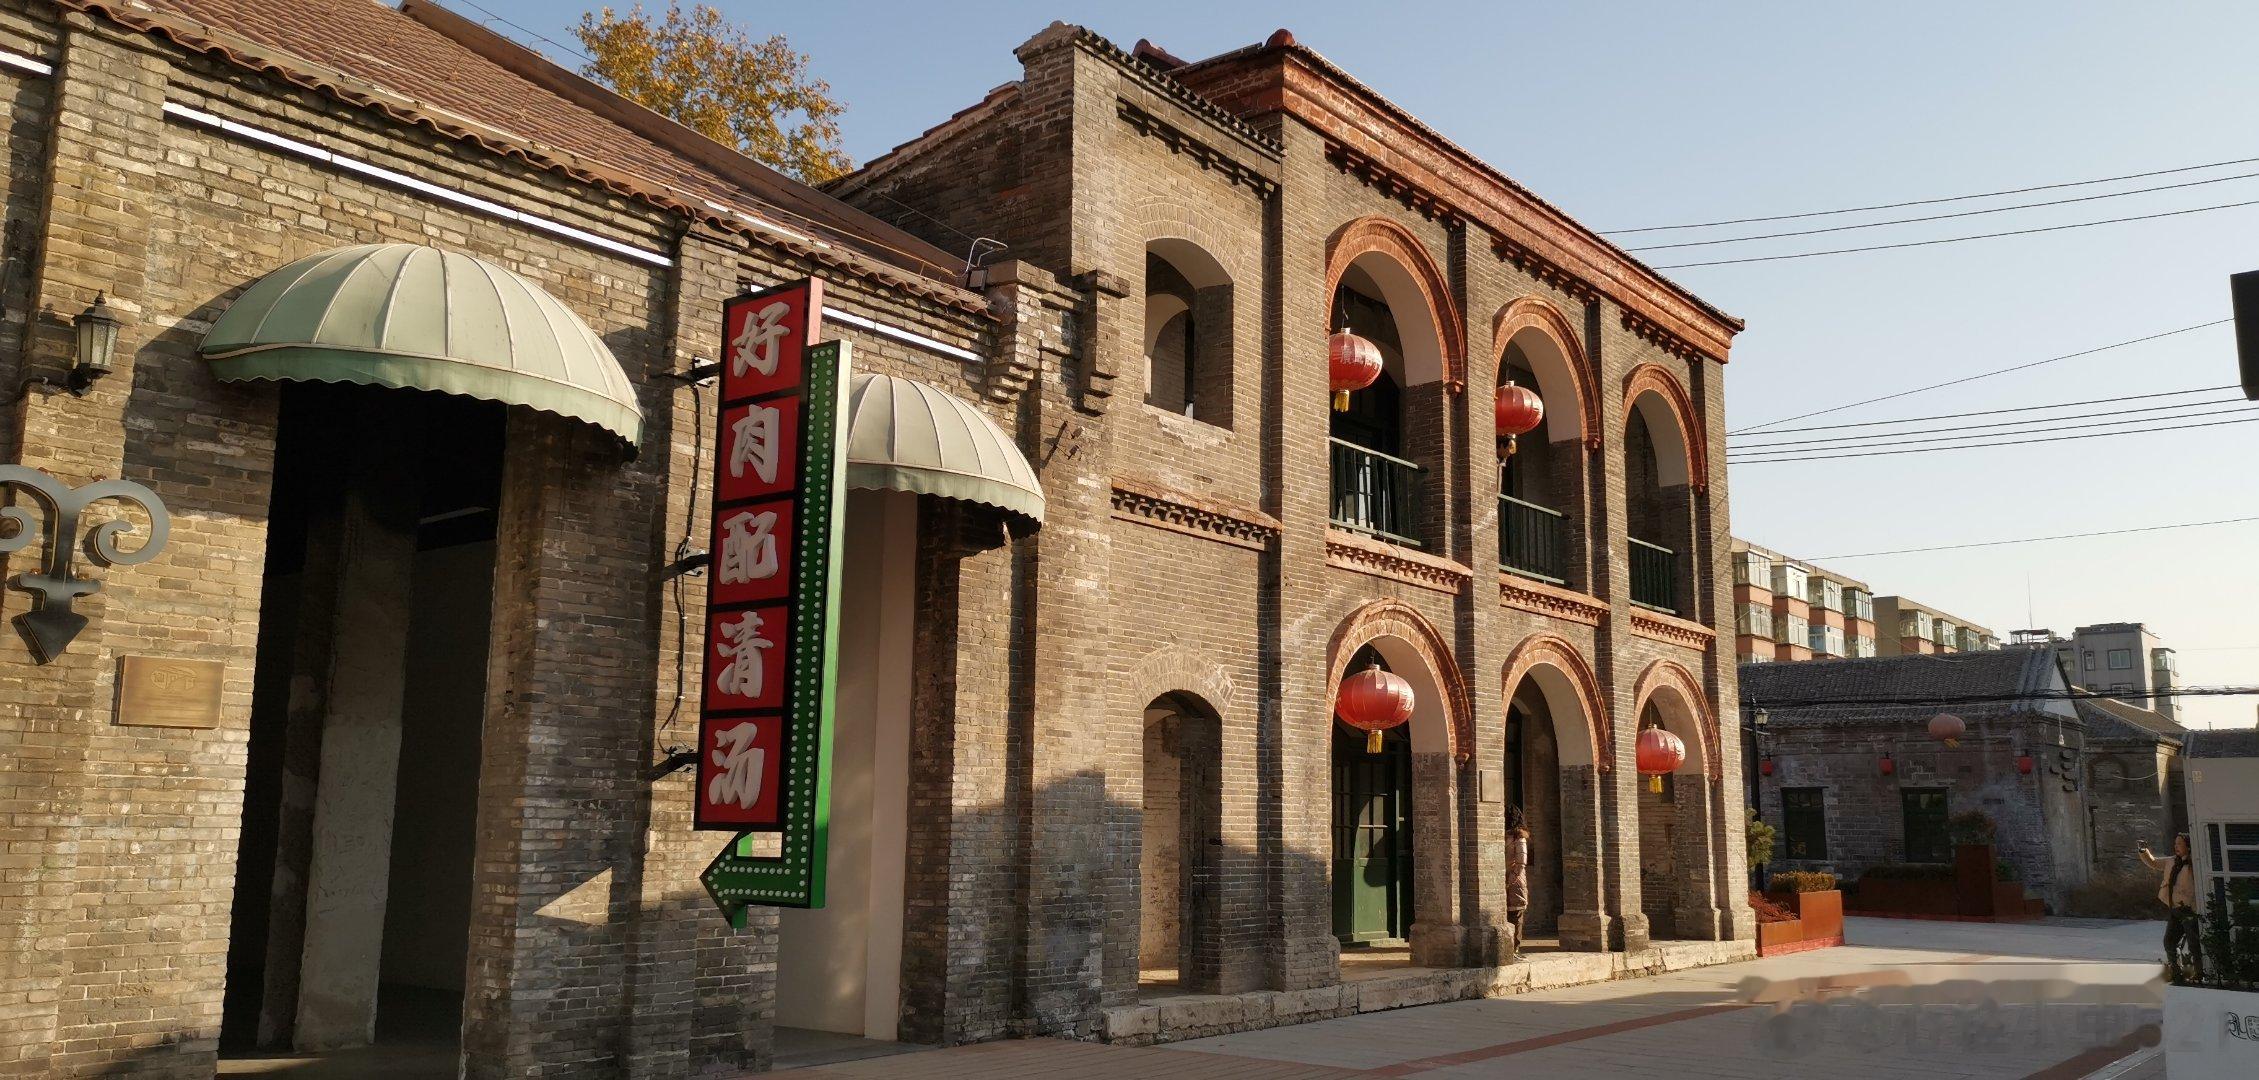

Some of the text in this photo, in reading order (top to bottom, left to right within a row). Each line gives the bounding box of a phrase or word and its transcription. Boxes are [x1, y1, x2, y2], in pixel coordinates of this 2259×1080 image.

[708, 301, 791, 810] 好肉配清汤
